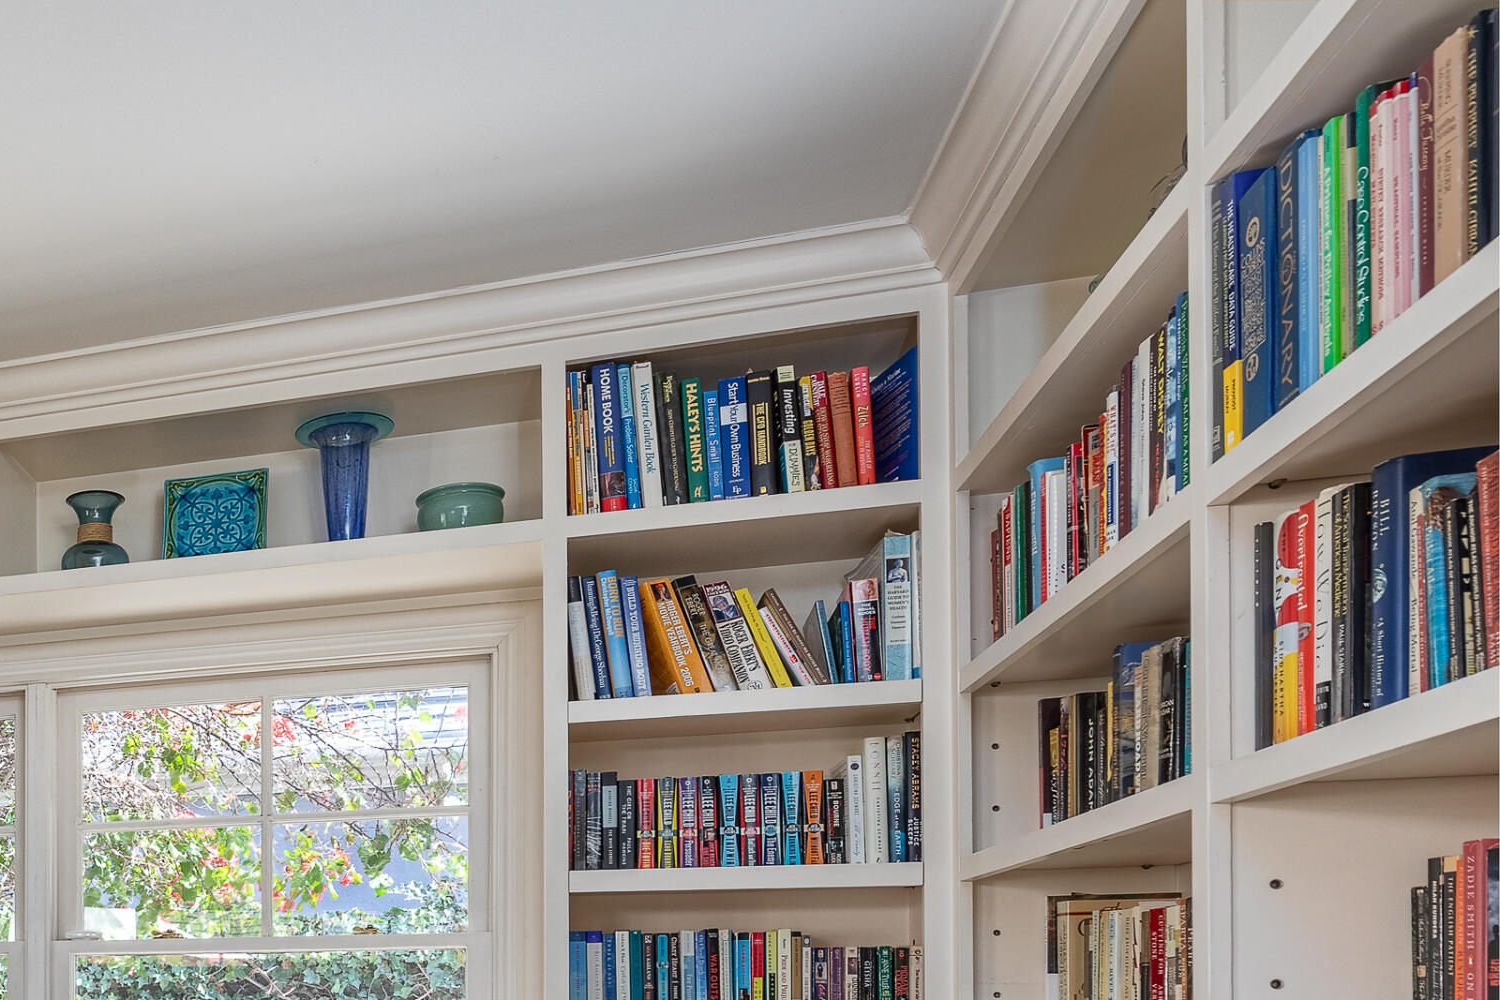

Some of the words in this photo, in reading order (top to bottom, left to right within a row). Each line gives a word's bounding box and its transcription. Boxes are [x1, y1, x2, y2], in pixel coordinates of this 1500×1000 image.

[1467, 49, 1477, 79] THE
[1468, 82, 1477, 149] PROPHET
[1418, 127, 1433, 171] Tuscany
[1324, 230, 1332, 251] for
[1280, 158, 1293, 386] DICTIONARY
[1324, 253, 1333, 297] Policy
[1324, 299, 1333, 357] Analysis
[599, 368, 612, 401] HOME
[621, 375, 632, 414] Decorator's
[727, 382, 740, 405] Start
[818, 380, 826, 399] DALE
[639, 383, 650, 418] Western
[685, 383, 701, 433] HALEY'S
[755, 402, 766, 415] THE
[783, 388, 797, 434] Investing
[602, 402, 614, 434] BOOK
[706, 397, 717, 437] Blueprint
[729, 405, 739, 424] Your
[755, 415, 766, 429] CFO
[819, 407, 828, 422] HOW
[821, 422, 829, 432] TO
[857, 405, 870, 429] Zilch
[625, 418, 635, 444] Problem
[642, 419, 654, 450] Garden
[729, 424, 740, 444] Own
[802, 419, 815, 442] GOLDEN
[821, 432, 831, 449] STOP
[626, 444, 635, 464] Solver
[689, 434, 703, 473] HINTS
[709, 440, 719, 463] Small
[756, 429, 768, 466] HANDBOOK
[804, 442, 817, 457] DAYS
[645, 452, 656, 474] Book
[731, 443, 743, 478] Business
[788, 447, 801, 487] DUMMIES
[822, 449, 834, 486] WORRYING
[1341, 492, 1351, 514] The
[1409, 500, 1419, 525] Atul
[1333, 512, 1342, 525] of
[1341, 513, 1351, 543] Social
[1379, 498, 1391, 537] BILL
[1468, 515, 1476, 544] ANCHOR
[1315, 498, 1332, 564] How
[1333, 524, 1343, 571] American
[1409, 526, 1418, 580] Gawande
[1425, 523, 1434, 565] Pocket
[1340, 544, 1351, 616] Transformation
[1471, 564, 1478, 574] OF
[607, 575, 620, 604] BORN
[626, 586, 638, 611] BUILD
[1315, 568, 1331, 612] We
[1333, 572, 1344, 618] Medicine
[1471, 574, 1479, 599] WORLD
[611, 605, 621, 616] TO
[684, 597, 698, 617] EBERT
[691, 592, 706, 617] ROGER
[1408, 598, 1419, 632] Being
[612, 617, 623, 638] RUN
[629, 611, 640, 632] YOUR
[666, 600, 680, 626] ROGER
[674, 626, 693, 656] EBERT'S
[718, 623, 735, 645] VIDEO
[730, 619, 750, 645] ROGER
[860, 617, 869, 647] HUMAN
[656, 602, 669, 627] MOVIE
[663, 627, 686, 667] YEARBOOK
[679, 668, 694, 687] 2006
[1315, 619, 1329, 670] Die
[1338, 623, 1346, 647] PAUL
[1375, 629, 1385, 653] Short
[631, 632, 643, 669] RUNNING
[738, 644, 762, 672] EBERT'S
[862, 649, 872, 672] BODY
[1338, 647, 1346, 676] STARR
[1409, 633, 1419, 674] Mortal
[595, 662, 606, 689] Sheehan
[725, 644, 751, 683] COMPANION
[1375, 654, 1385, 686] History
[634, 669, 645, 691] BODY
[1375, 687, 1385, 697] of
[911, 737, 920, 771] STACEY
[663, 798, 674, 809] LEE
[682, 797, 694, 809] LEE
[701, 796, 714, 808] LEE
[725, 794, 733, 805] LEE
[744, 794, 756, 806] LEE
[764, 793, 777, 805] LEE
[787, 793, 796, 804] LEE
[809, 791, 818, 802] LEE
[893, 792, 901, 814] EDGE
[911, 773, 920, 810] ABRAMS
[663, 809, 674, 826] CHILD
[682, 809, 694, 828] CHILD
[702, 808, 715, 827] CHILD
[725, 805, 734, 822] CHILD
[744, 805, 756, 823] CHILD
[765, 805, 777, 824] CHILD
[787, 804, 797, 821] CHILD
[809, 802, 819, 819] CHILD
[684, 839, 694, 866] Persuader
[766, 837, 777, 847] The
[894, 830, 902, 856] EARTH
[765, 847, 777, 865] Enemy
[1447, 876, 1455, 894] THE
[1466, 855, 1475, 899] ZADIE
[1447, 896, 1455, 937] ENGLISH
[1466, 904, 1475, 950] SMITH
[670, 936, 678, 957] CRAZY
[1447, 939, 1455, 977] PATIENT
[710, 953, 718, 974] WAR
[863, 960, 873, 988] GEISHA
[881, 958, 889, 974] ANNE
[881, 974, 890, 990] TYLER
[900, 965, 908, 996] PRIMARY
[1466, 972, 1475, 992] ON
